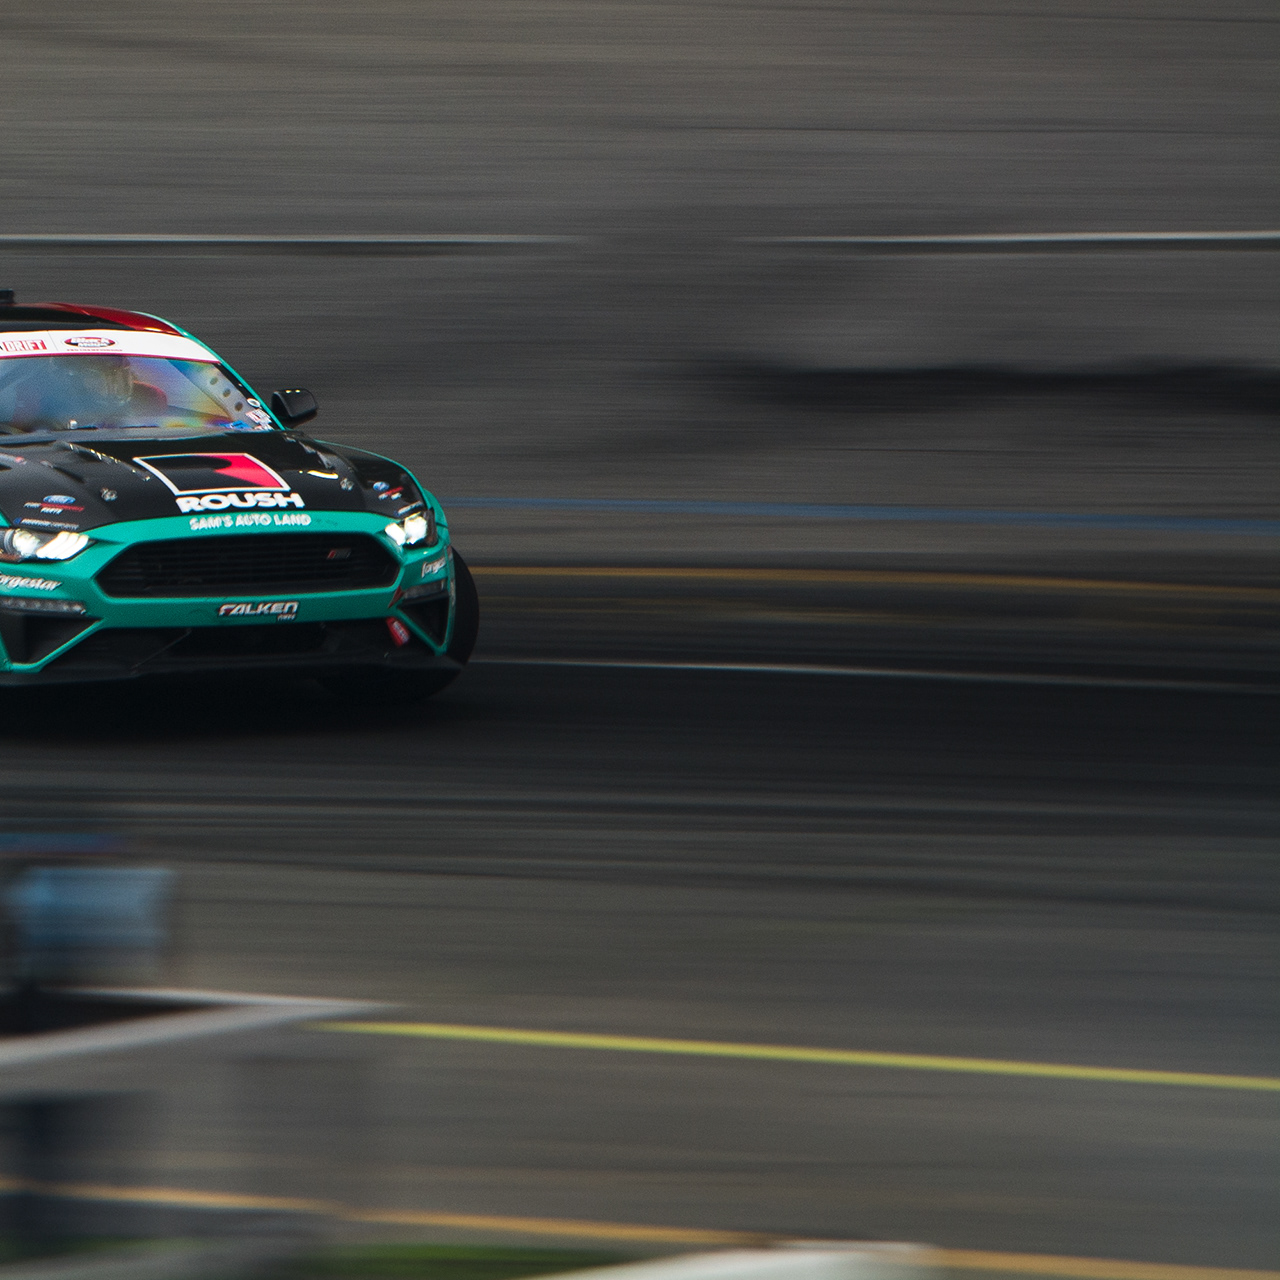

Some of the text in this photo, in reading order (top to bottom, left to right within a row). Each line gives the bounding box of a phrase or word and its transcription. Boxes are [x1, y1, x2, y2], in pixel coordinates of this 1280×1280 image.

[3, 340, 47, 352] DRIFT
[175, 493, 306, 513] ROUSH
[190, 513, 312, 531] SAM'S AUTO LAND
[218, 601, 299, 616] FALKEN
